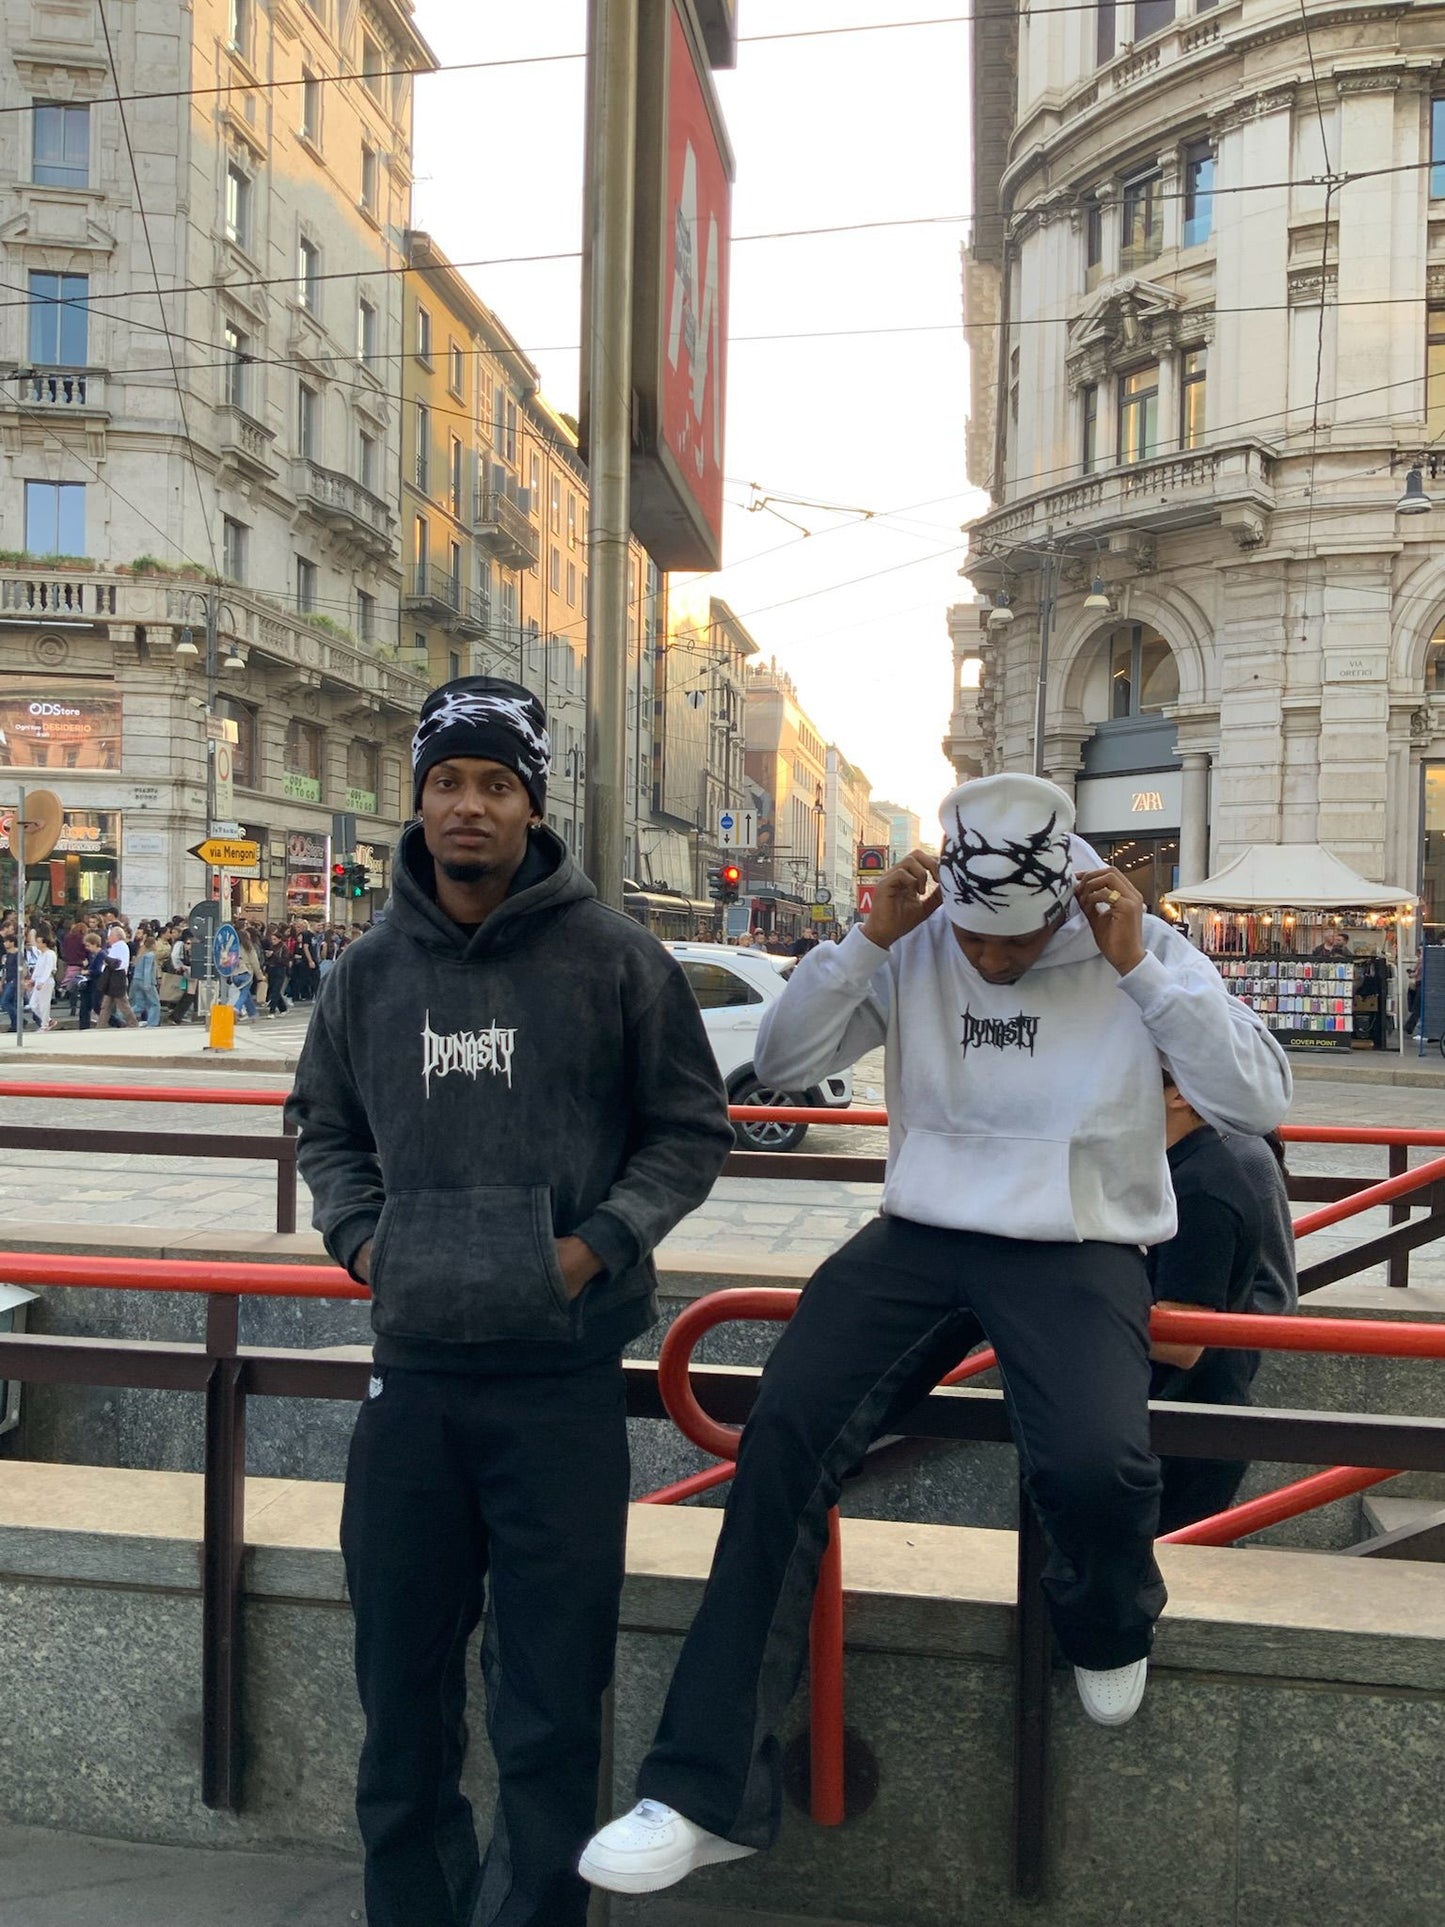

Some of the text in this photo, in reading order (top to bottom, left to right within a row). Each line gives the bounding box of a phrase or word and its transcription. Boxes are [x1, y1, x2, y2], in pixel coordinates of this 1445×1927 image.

[1349, 660, 1363, 668] VIA
[29, 703, 81, 716] ODStore
[42, 723, 92, 733] DESIDERIO
[1132, 791, 1164, 812] ZARA
[210, 845, 256, 861] via Mengoni
[960, 1002, 1041, 1060] DYNASTY
[1290, 1038, 1337, 1047] COVER POINT
[420, 1008, 518, 1099] DYNASTY
